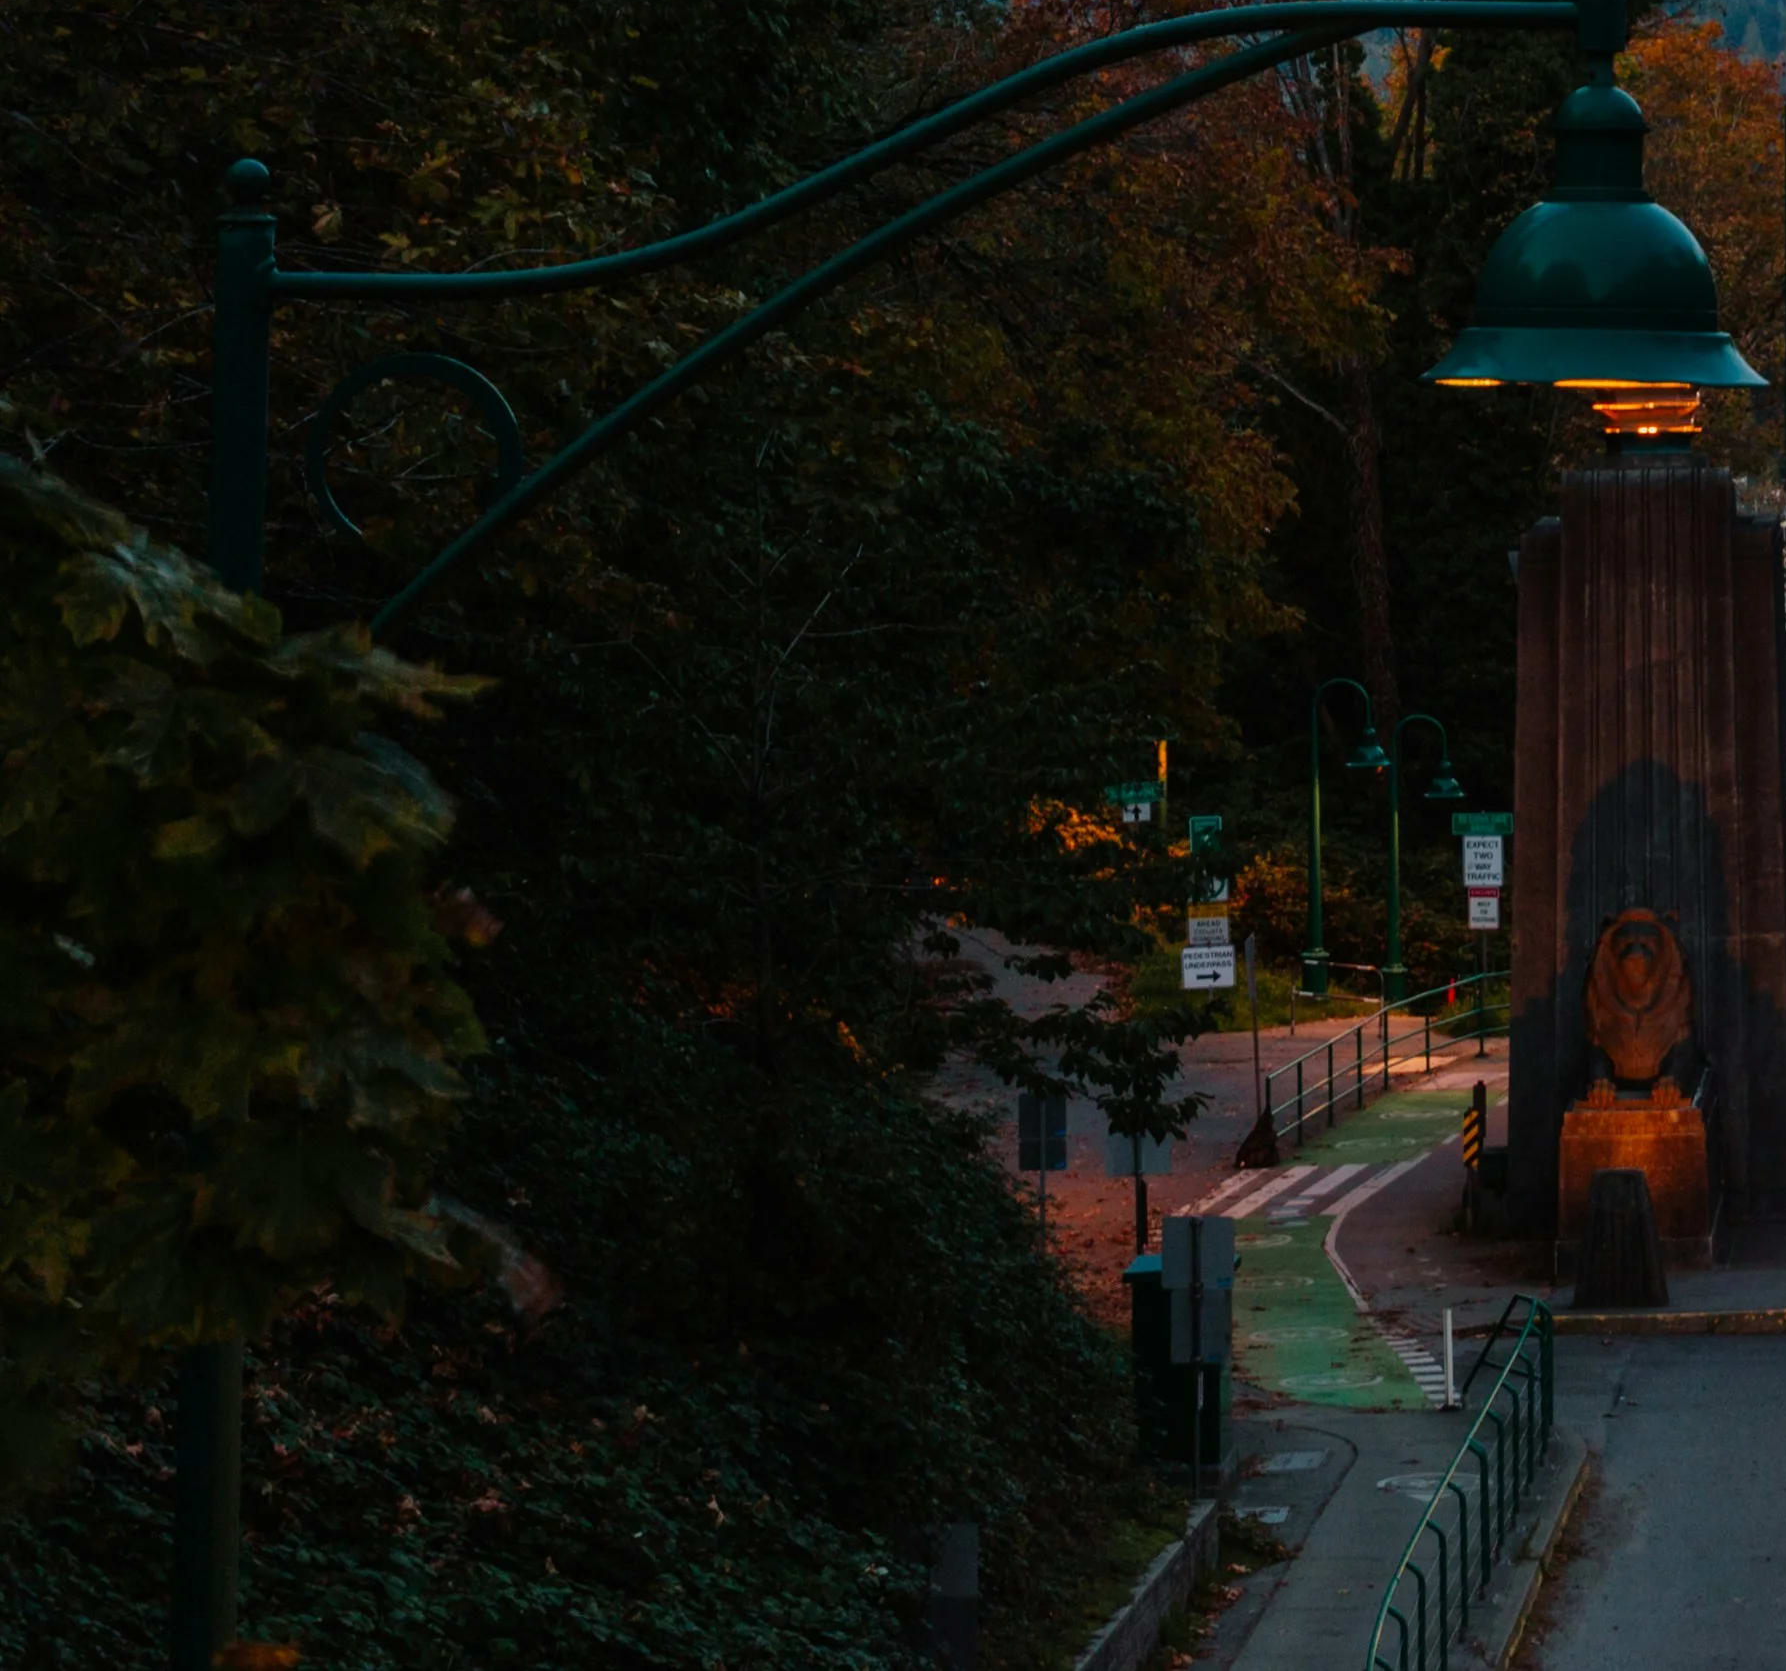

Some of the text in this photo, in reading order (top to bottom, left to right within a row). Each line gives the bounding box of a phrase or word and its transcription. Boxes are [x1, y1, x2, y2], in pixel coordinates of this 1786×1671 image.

[1467, 841, 1499, 849] EXPECT
[1474, 852, 1493, 860] TWO
[1475, 863, 1492, 871] WAY
[1466, 873, 1500, 881] TRAFFIC
[1183, 951, 1233, 960] PEDESTRIAN
[1184, 961, 1232, 970] UNDERPASS
